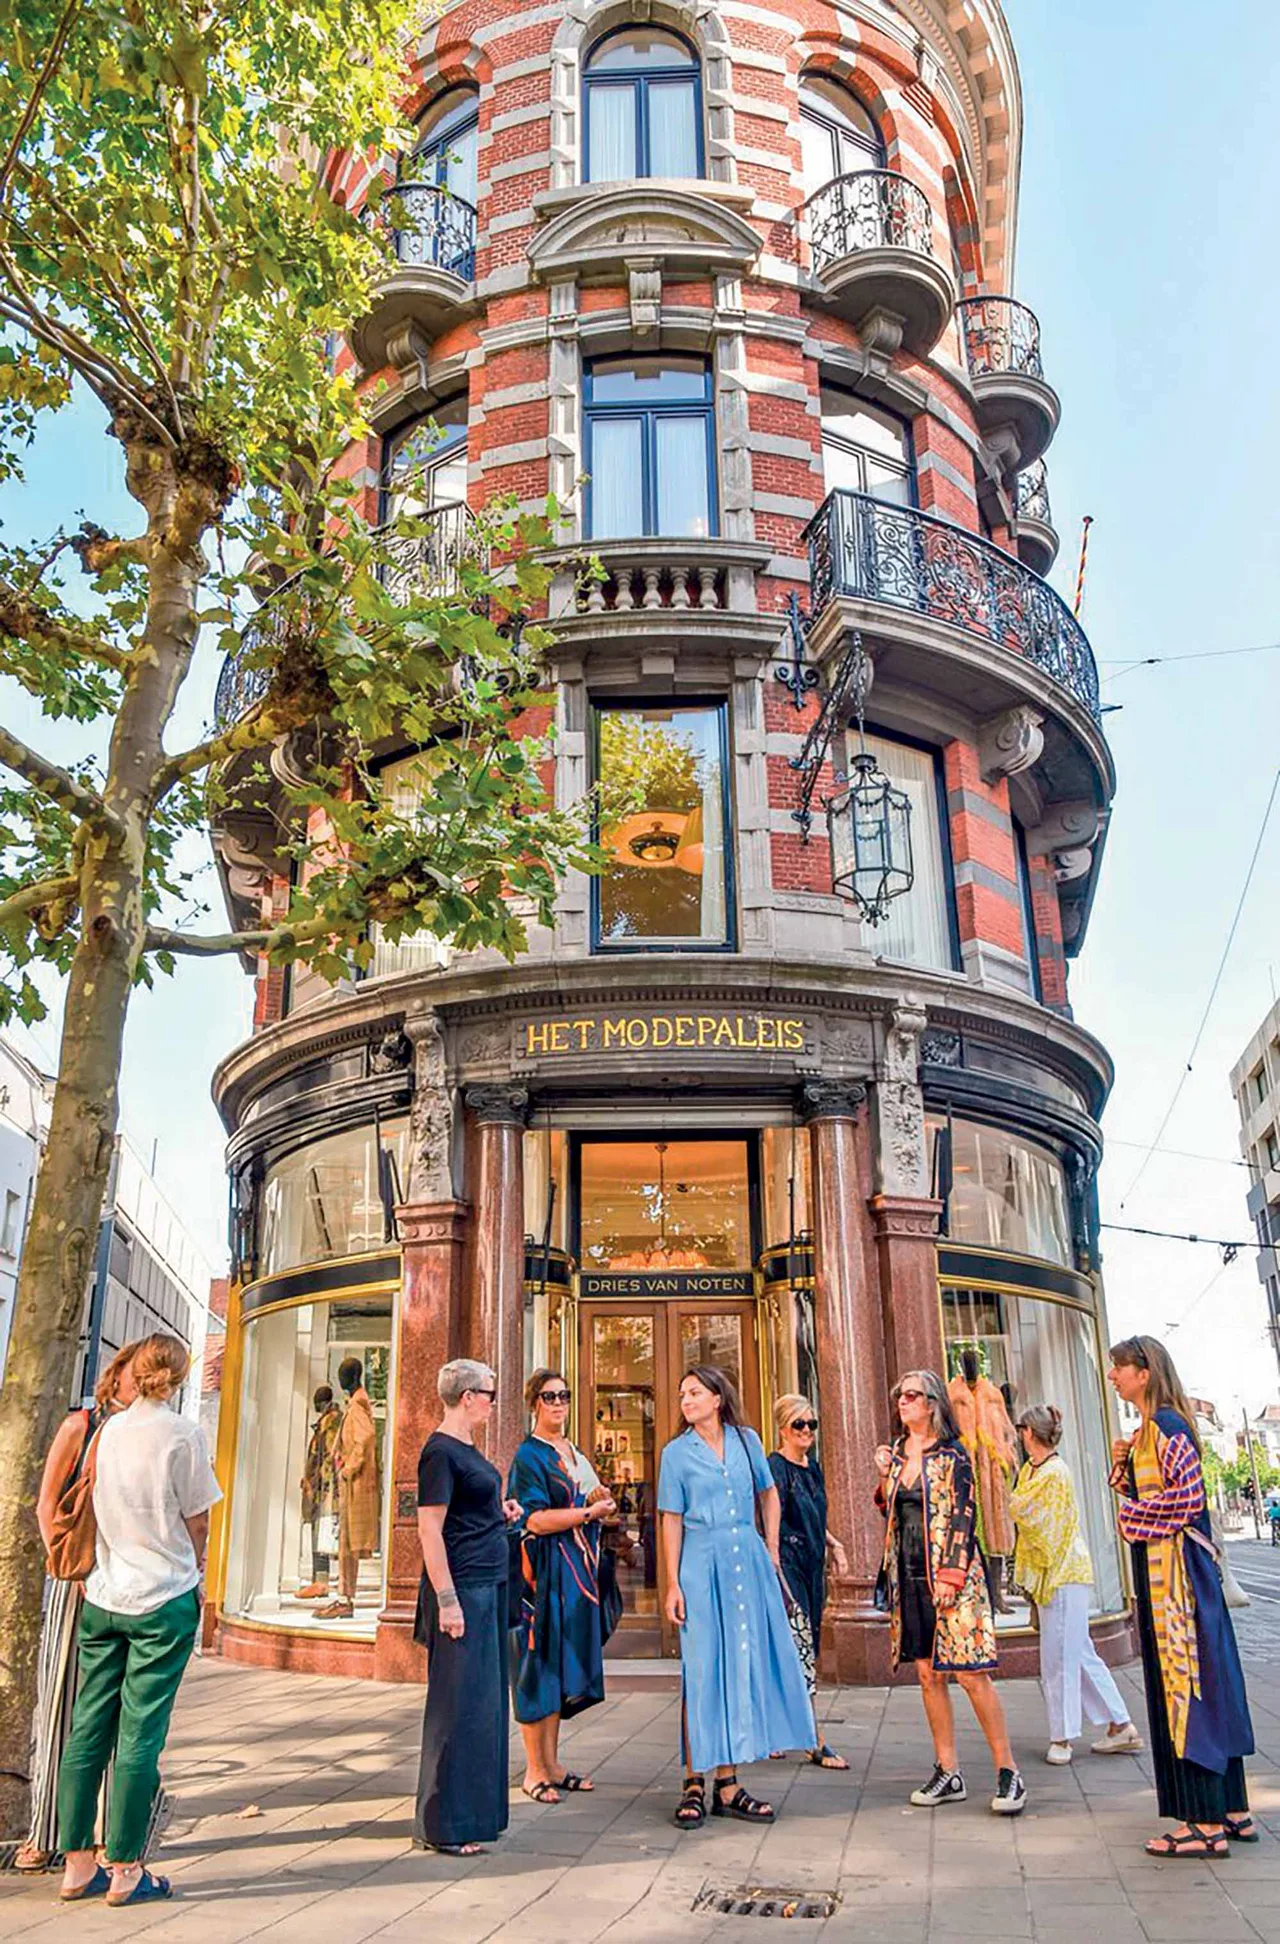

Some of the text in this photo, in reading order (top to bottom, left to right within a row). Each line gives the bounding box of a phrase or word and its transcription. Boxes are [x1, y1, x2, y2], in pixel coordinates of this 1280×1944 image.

[527, 1017, 805, 1053] HET MODEPALEIS
[587, 1278, 746, 1292] DRIES VAN NOTEN
